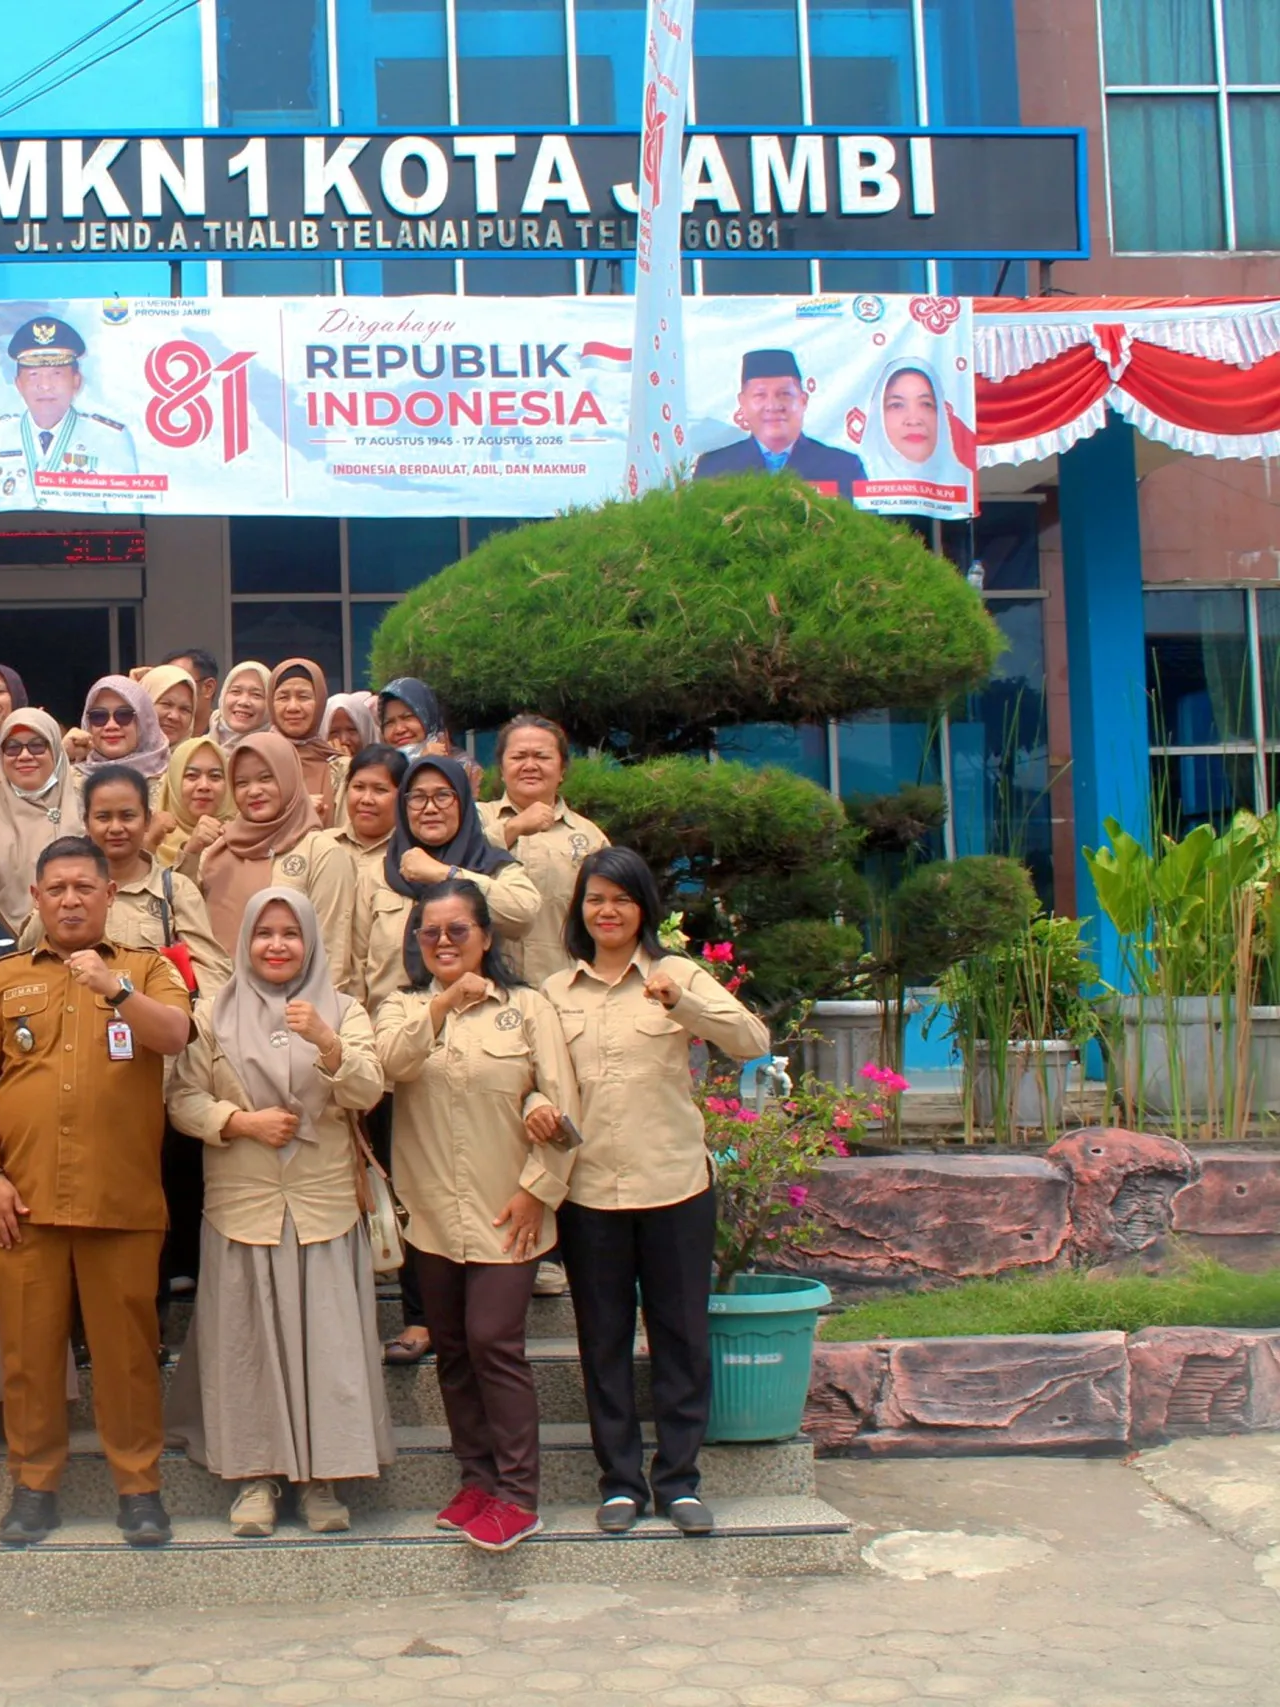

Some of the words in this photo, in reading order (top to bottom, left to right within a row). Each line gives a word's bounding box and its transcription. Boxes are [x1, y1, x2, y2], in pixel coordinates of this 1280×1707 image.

[227, 137, 269, 219] 1
[303, 134, 592, 219] KOTA
[134, 308, 179, 316] PROVINSI
[182, 308, 211, 316] JAMBI
[318, 307, 457, 344] Dirgahayu
[305, 343, 571, 379] REPUBLIK
[143, 339, 258, 464] 81
[306, 390, 608, 427] INDONESIA
[354, 436, 365, 446] 17
[368, 436, 425, 447] AGUSTUS
[427, 437, 453, 447] 1945
[463, 437, 474, 447] 17
[477, 437, 533, 447] AGUSTUS
[535, 437, 564, 446] 2026
[71, 477, 107, 486] Abdullah
[332, 463, 396, 476] INDONESIA
[399, 463, 470, 477] BERDAULAT,
[472, 464, 503, 477] ADIL,
[505, 463, 531, 475] DAN
[533, 463, 587, 475] MAKMUR
